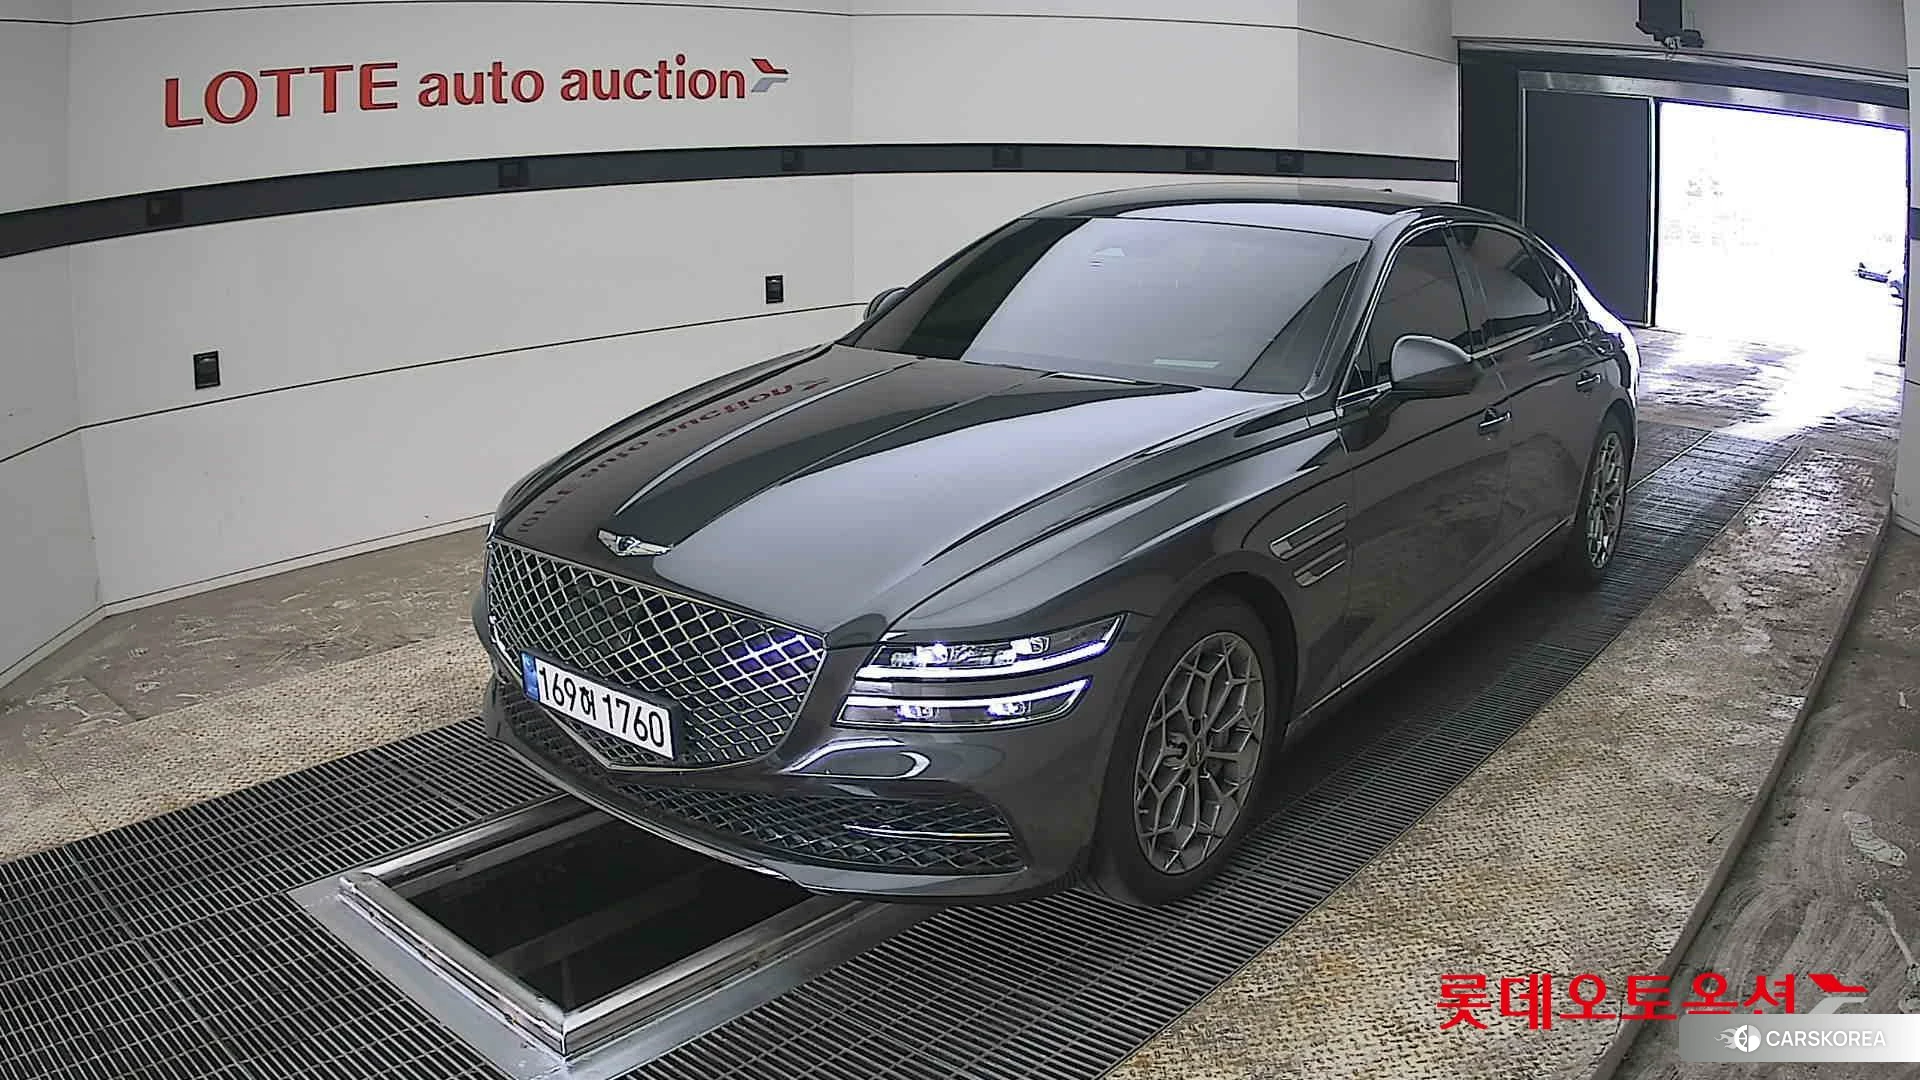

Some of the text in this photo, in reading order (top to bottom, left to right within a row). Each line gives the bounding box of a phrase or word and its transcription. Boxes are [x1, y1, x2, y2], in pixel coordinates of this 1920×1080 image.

[163, 53, 747, 128] LOTTE auto auction
